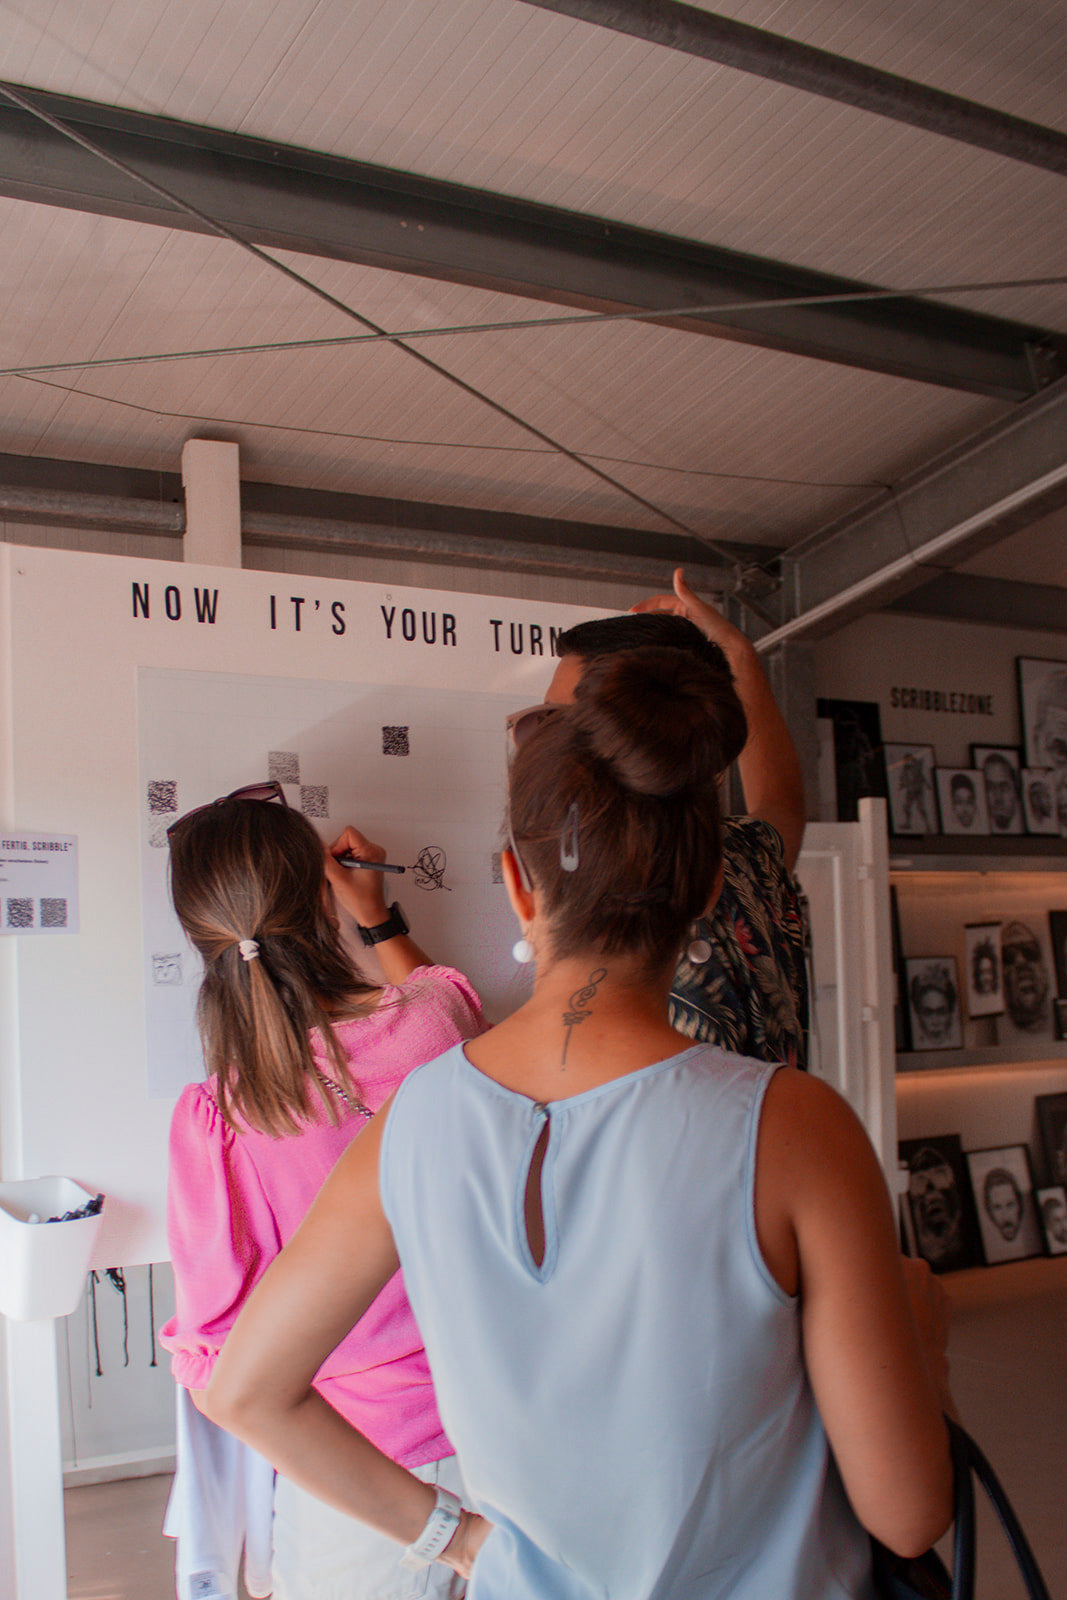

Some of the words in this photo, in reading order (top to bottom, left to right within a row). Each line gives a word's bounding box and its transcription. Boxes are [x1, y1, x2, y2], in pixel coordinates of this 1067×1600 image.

[131, 581, 219, 625] NOW
[270, 594, 346, 636] IT'S
[380, 604, 458, 647] YOUR
[890, 685, 994, 716] SCRIBBLEZONE
